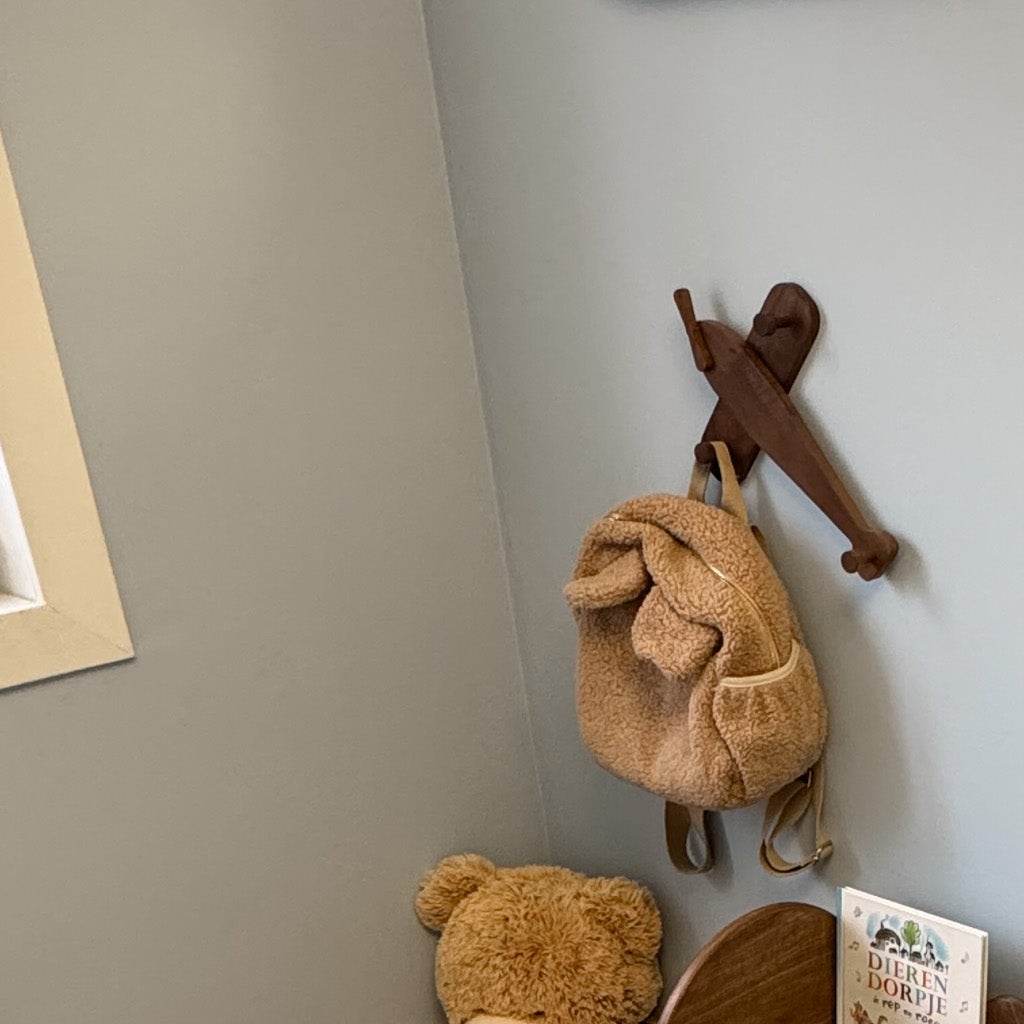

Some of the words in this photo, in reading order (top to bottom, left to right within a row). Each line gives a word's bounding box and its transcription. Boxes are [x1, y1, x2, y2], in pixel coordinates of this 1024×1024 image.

[868, 951, 948, 994] DIEREN
[868, 972, 948, 1016] DORPJE
[882, 1001, 900, 1012] rep
